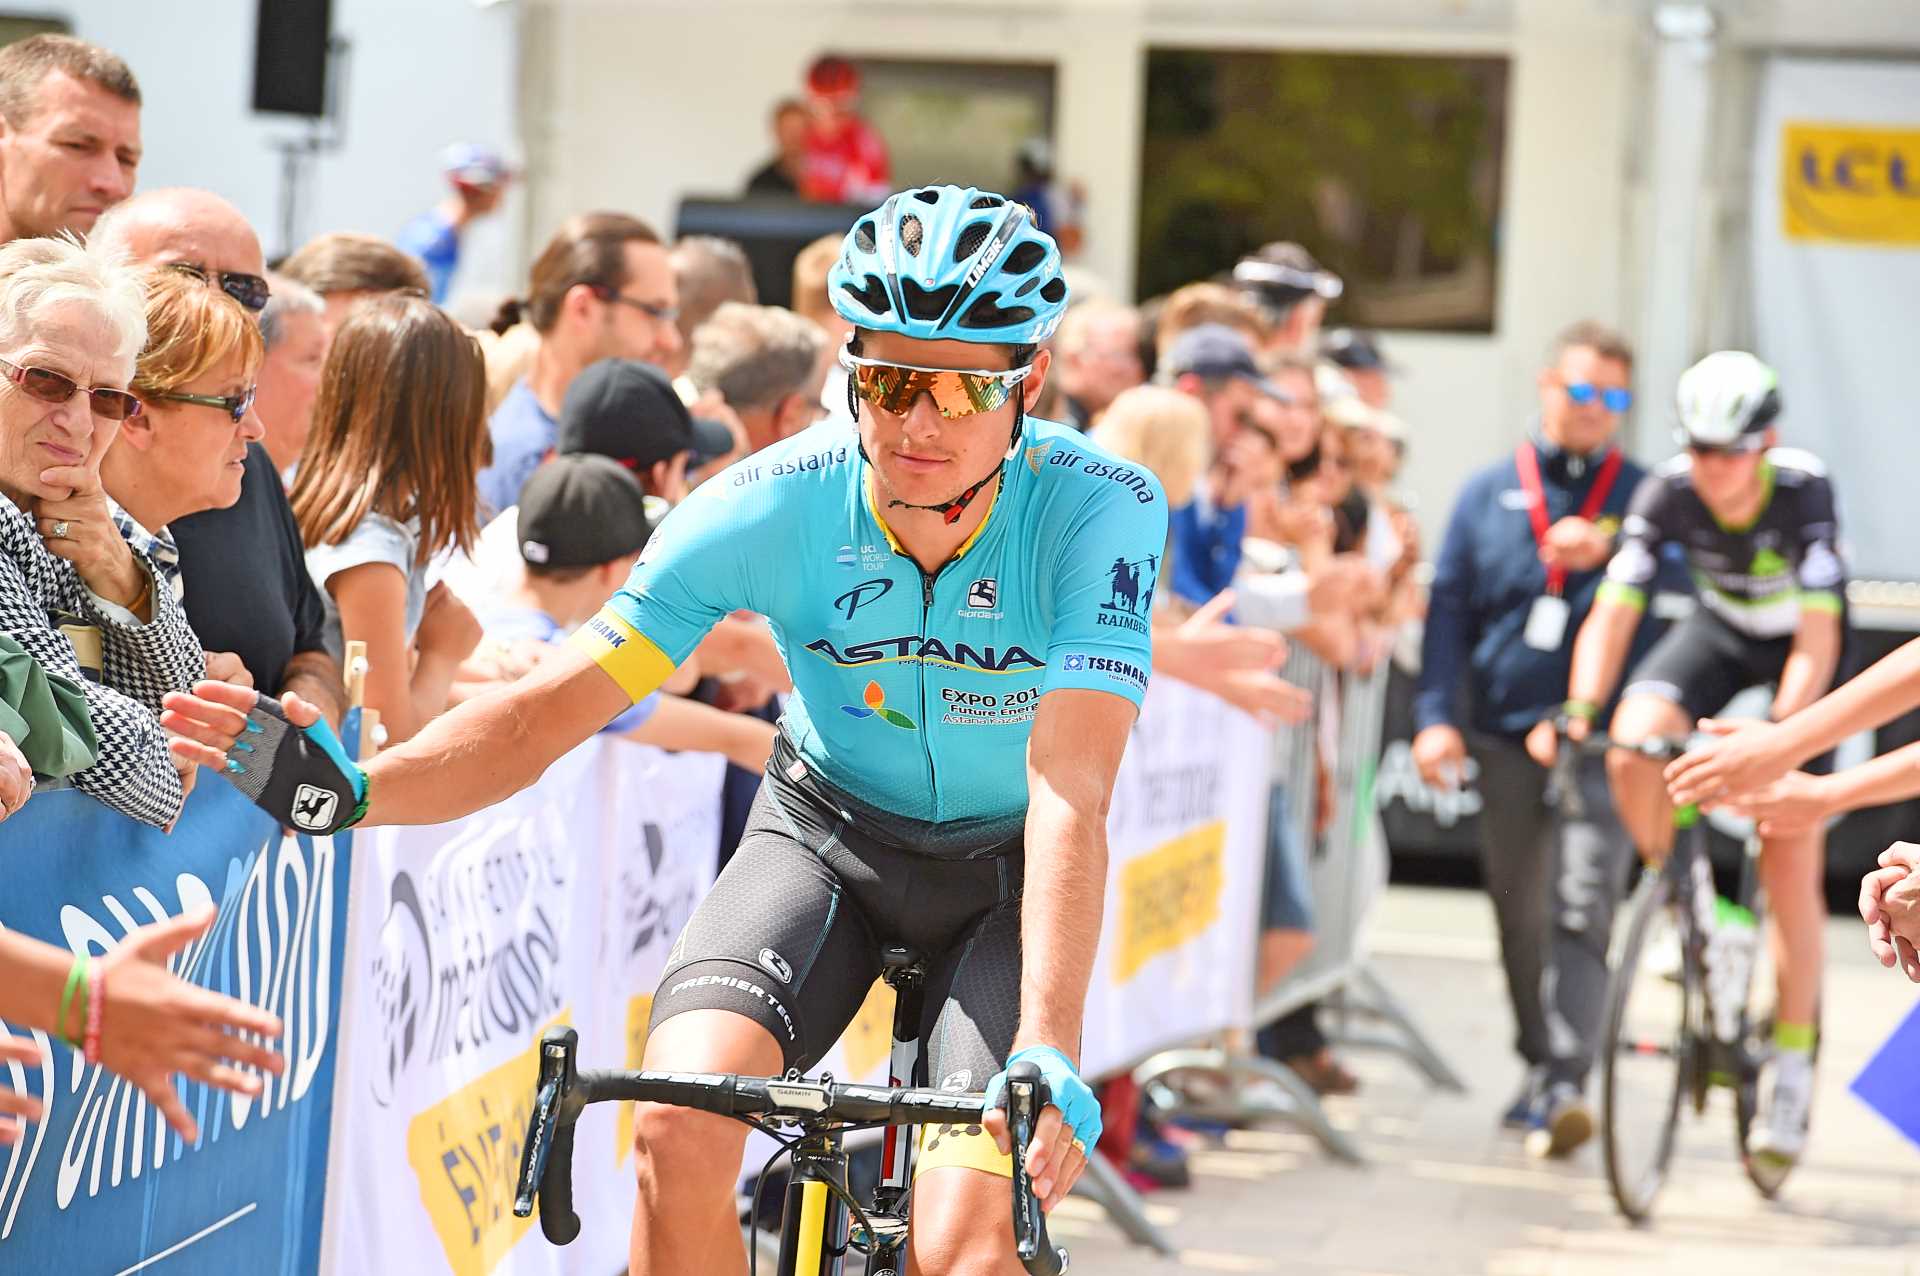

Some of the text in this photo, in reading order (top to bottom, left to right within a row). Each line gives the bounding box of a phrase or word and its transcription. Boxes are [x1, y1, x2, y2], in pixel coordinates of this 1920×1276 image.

[733, 447, 847, 487] air astana
[1049, 449, 1155, 505] air astana
[805, 635, 1047, 672] ASTANA
[1087, 656, 1150, 690] TSESNABA
[941, 685, 1043, 708] EXPO 201
[950, 704, 996, 717] Future
[670, 975, 796, 1041] PREMIER TECH
